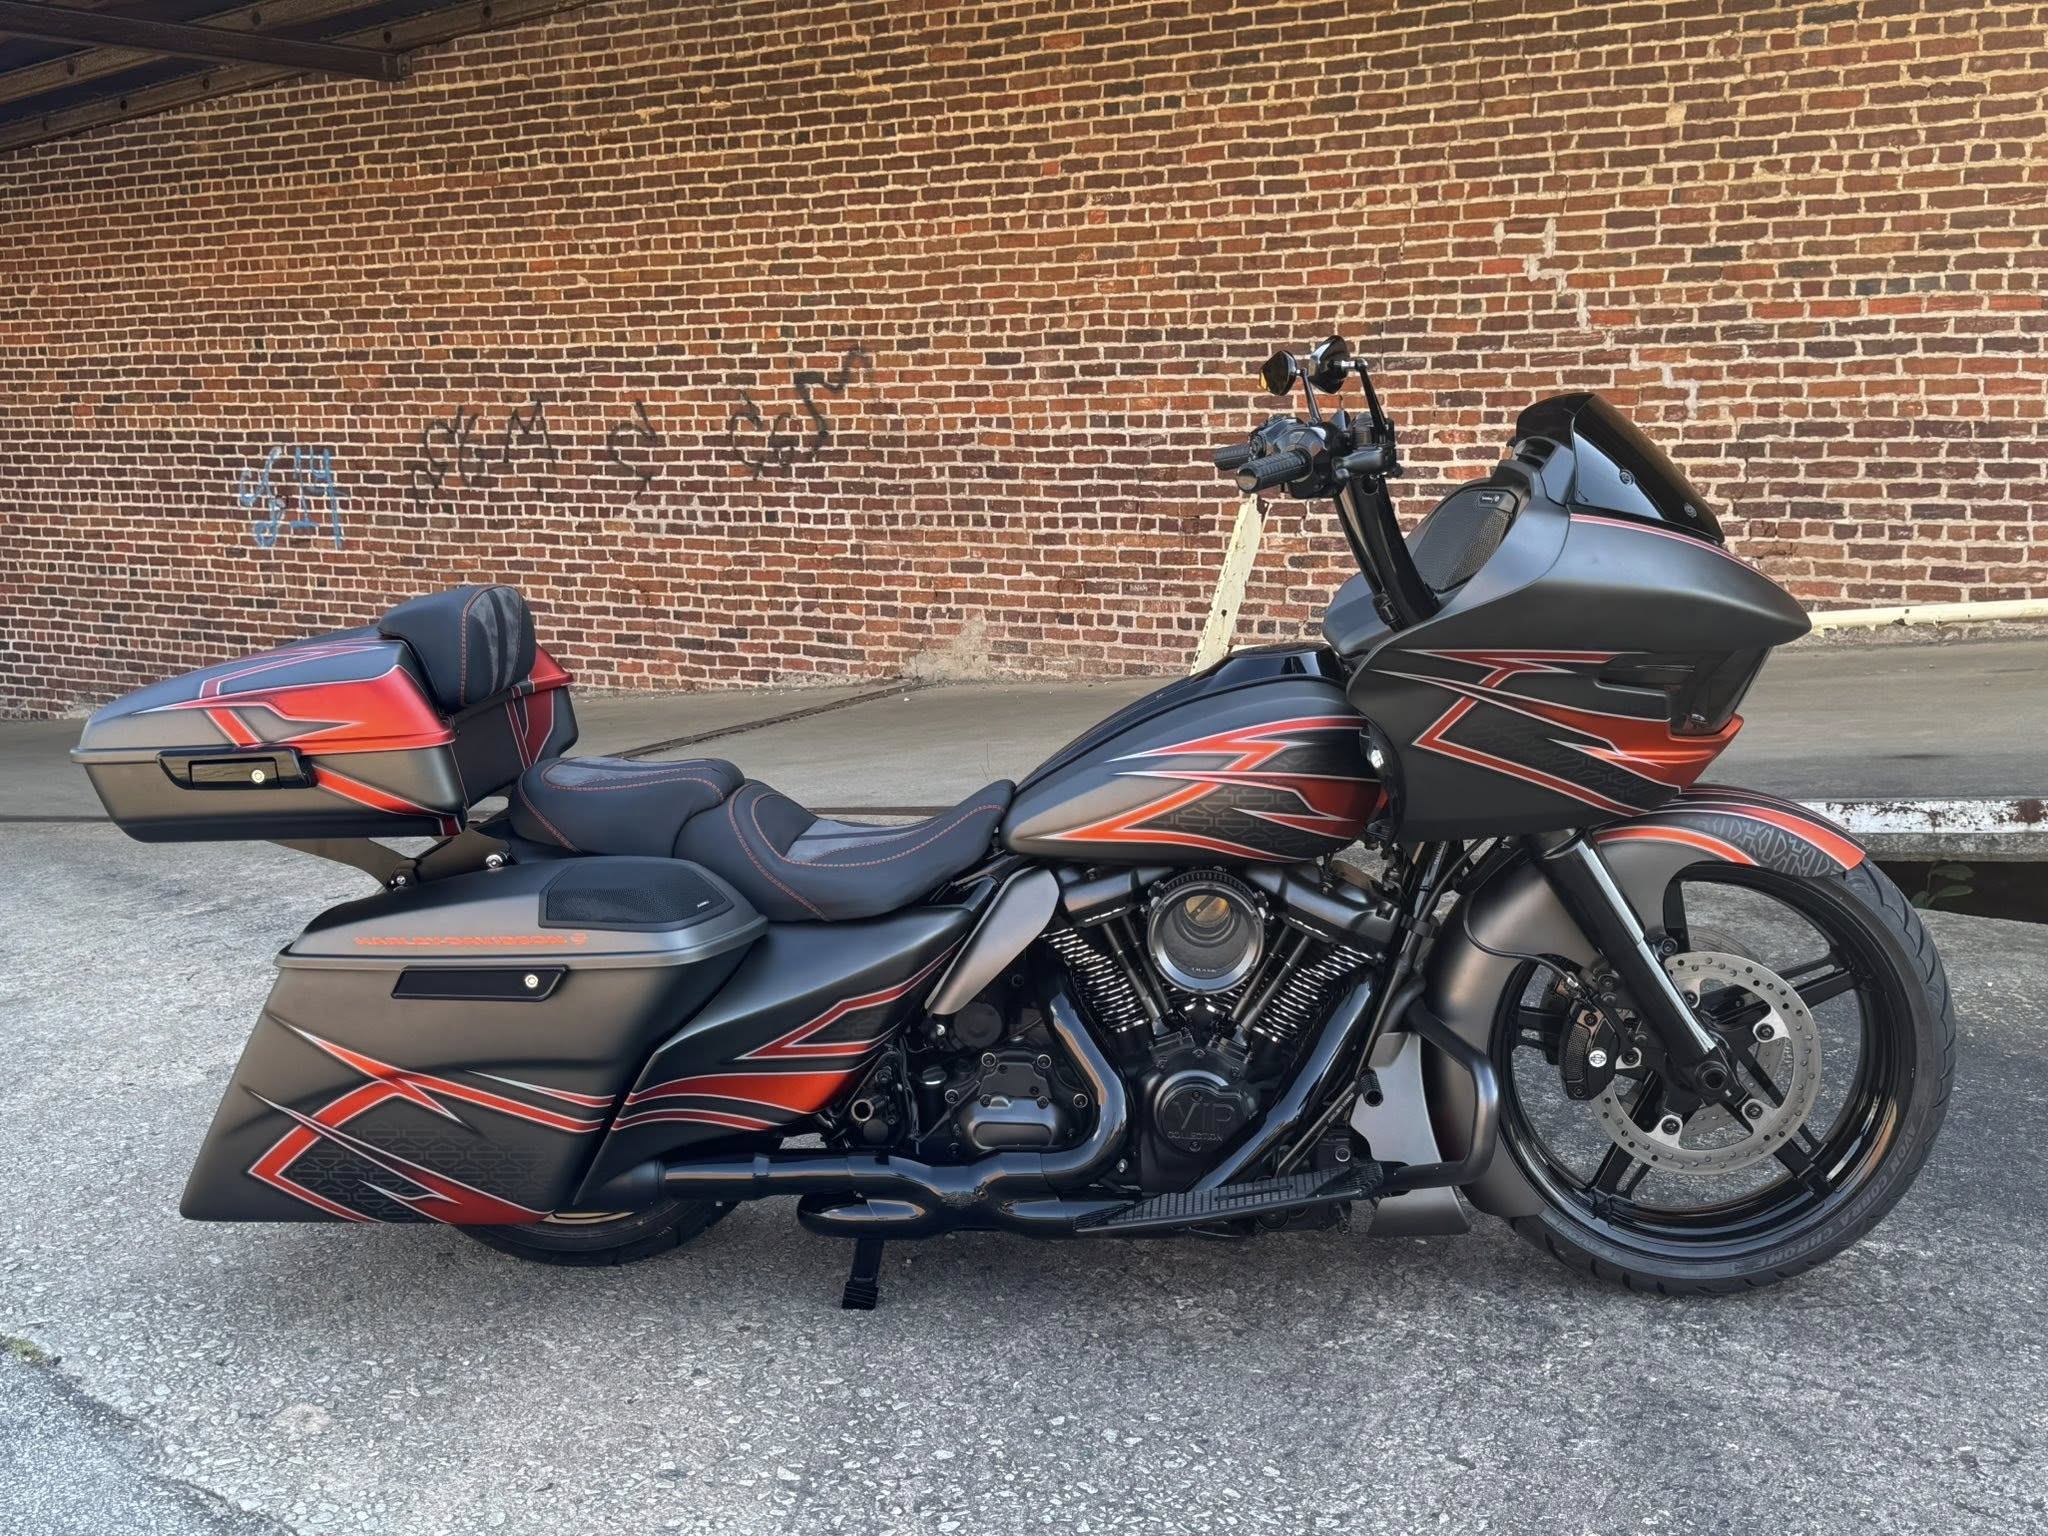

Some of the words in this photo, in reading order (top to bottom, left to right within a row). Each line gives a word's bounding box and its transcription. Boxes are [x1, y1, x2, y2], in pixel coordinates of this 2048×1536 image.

[1172, 1102, 1235, 1130] VIP
[1888, 1121, 1917, 1175] AVON
[1839, 1175, 1888, 1227] COBRA
[1751, 1226, 1834, 1269] CHROME
